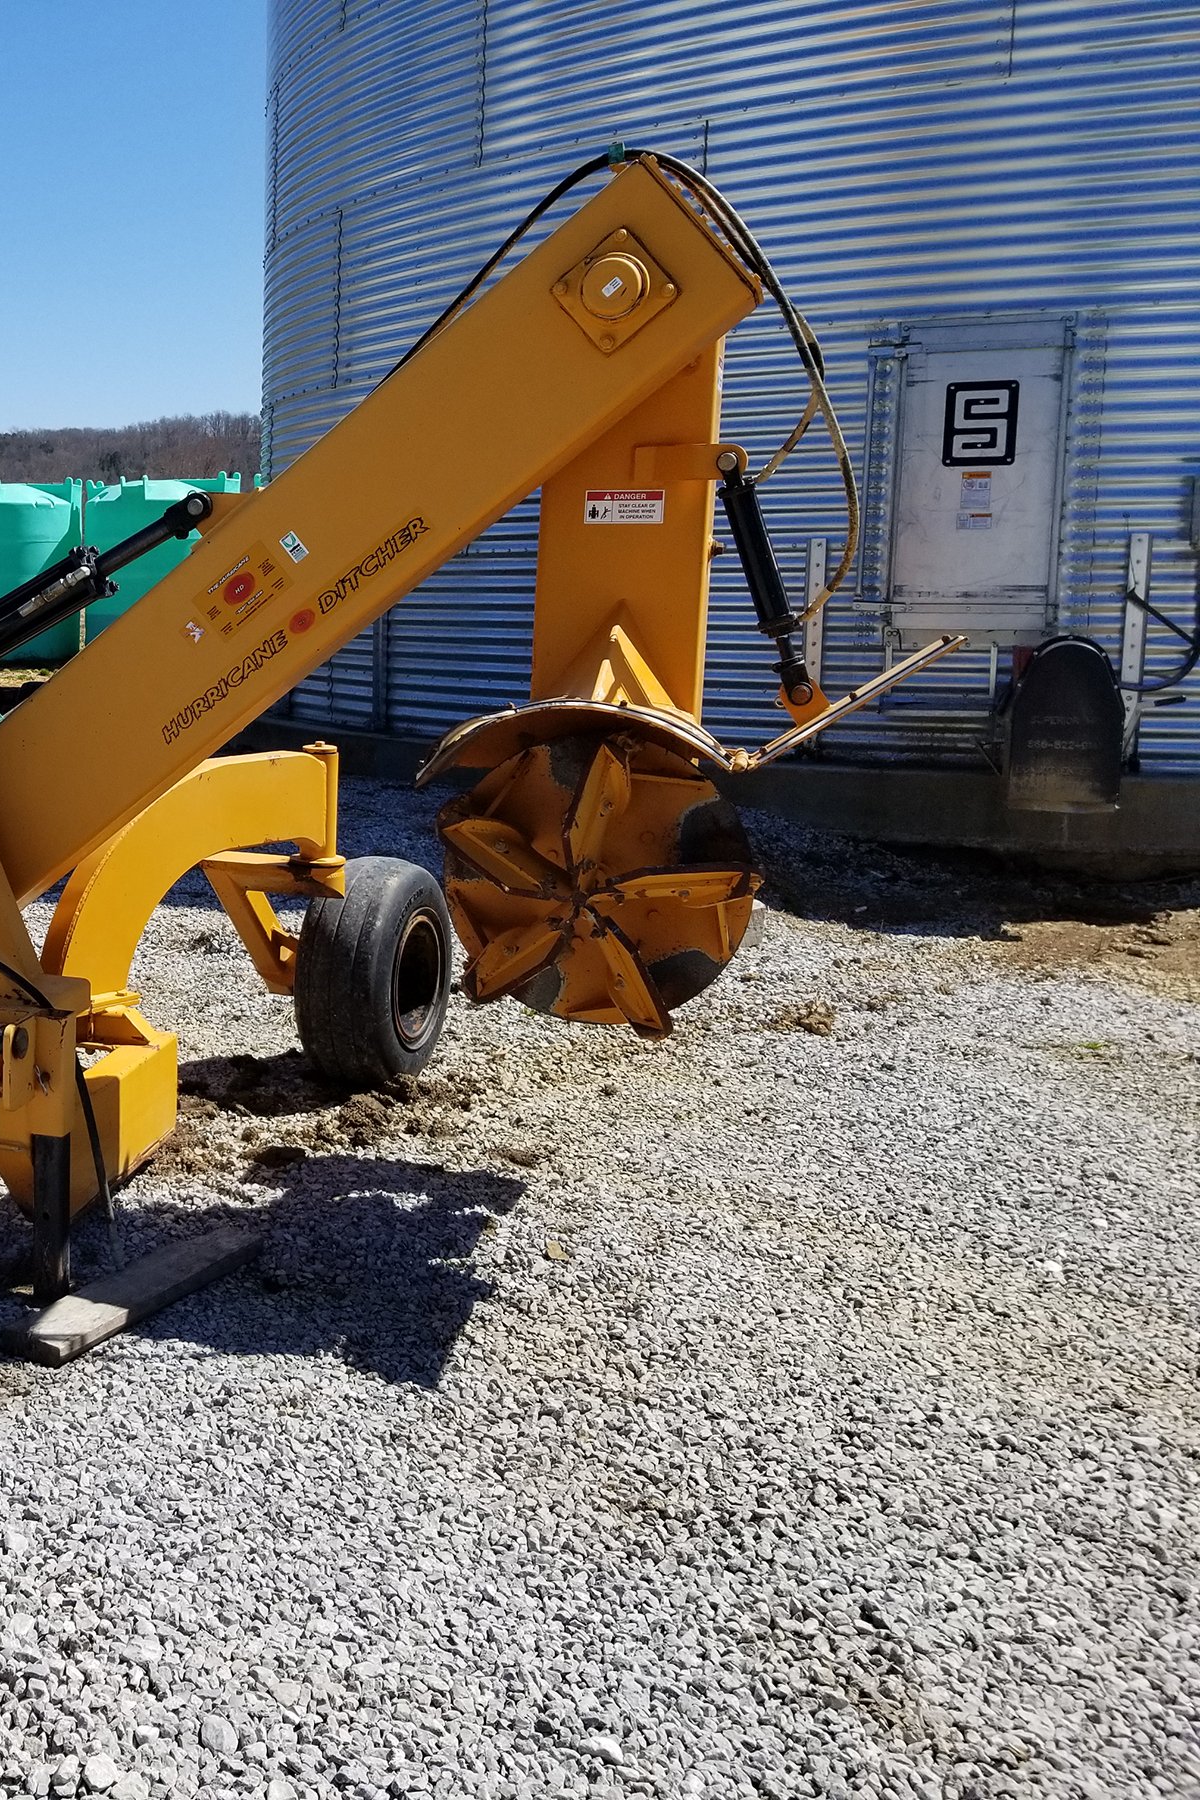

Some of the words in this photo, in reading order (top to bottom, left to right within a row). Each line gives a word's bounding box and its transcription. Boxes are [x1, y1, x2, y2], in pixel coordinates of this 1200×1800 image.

[207, 582, 220, 595] THE
[219, 555, 251, 587] HURRICANE
[234, 584, 246, 594] HD
[161, 629, 289, 745] HURRICANE
[318, 516, 431, 616] DITCHER
